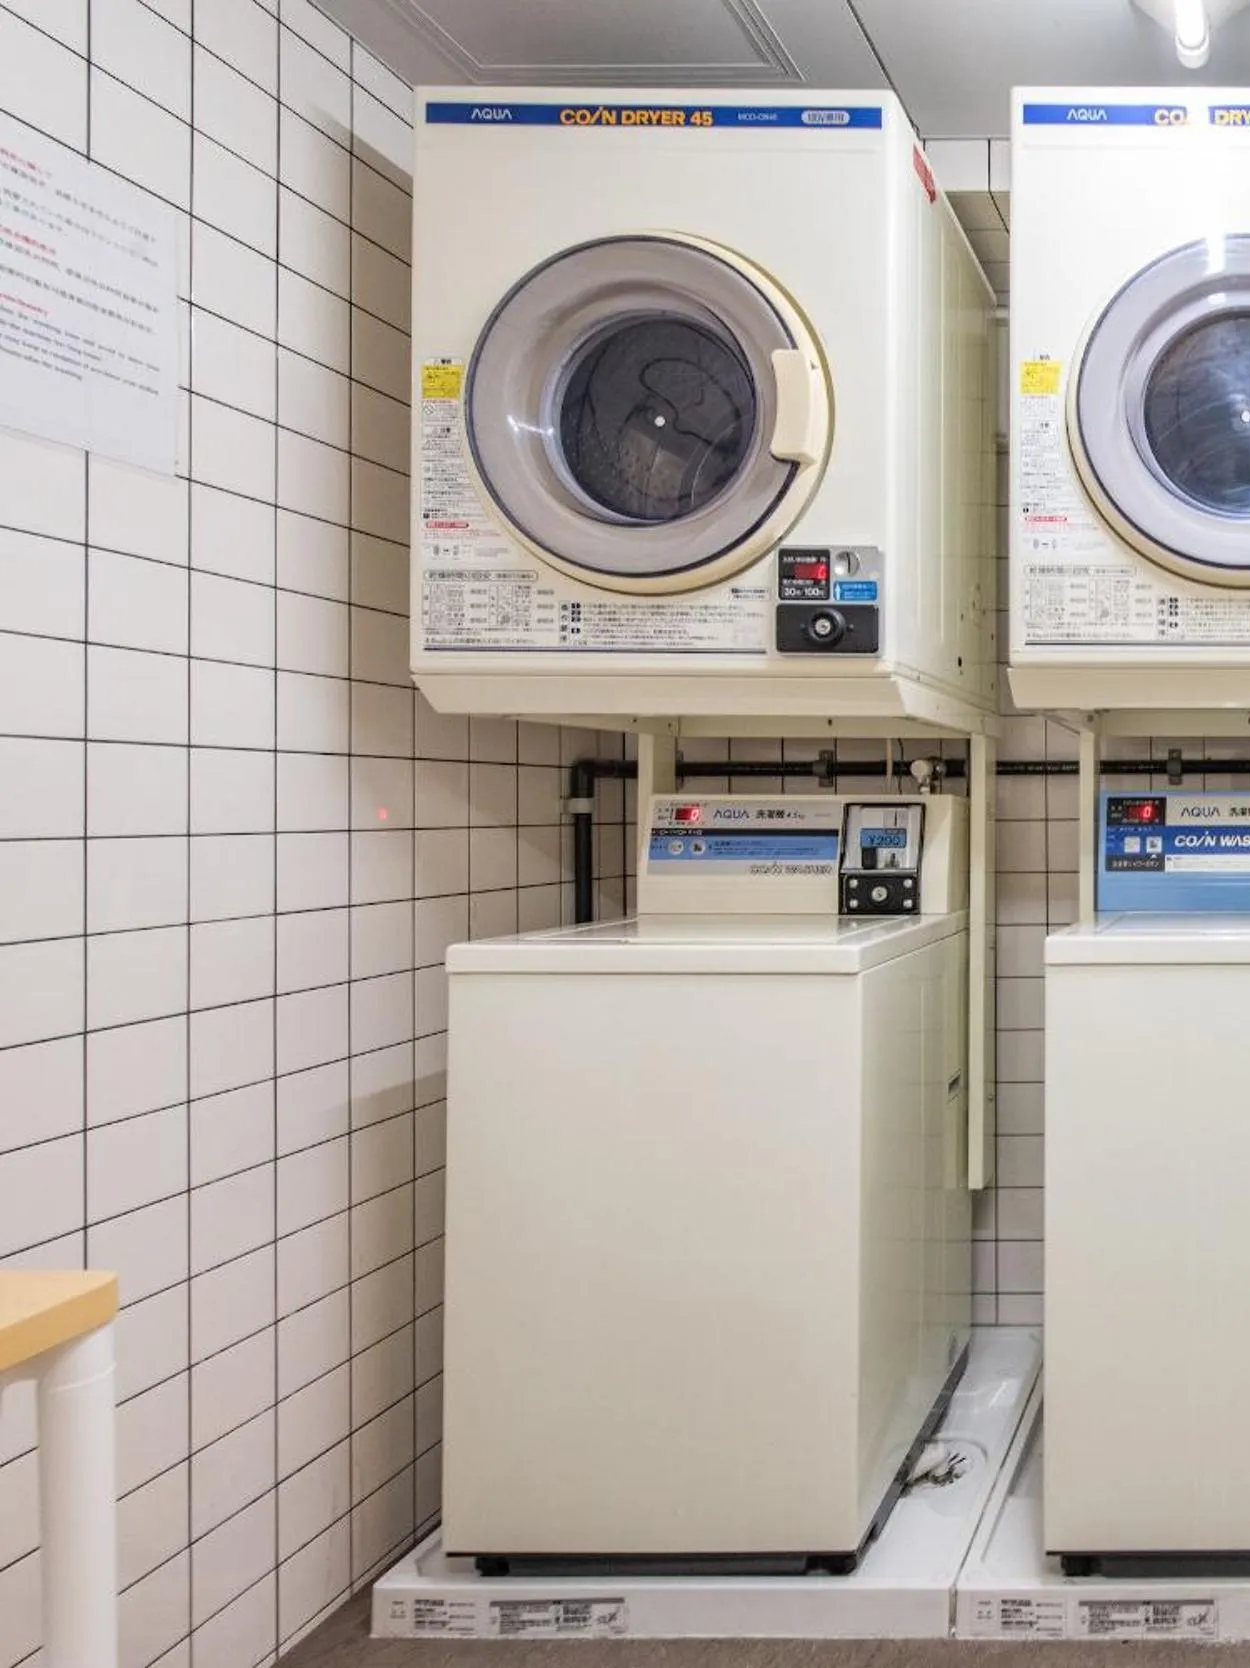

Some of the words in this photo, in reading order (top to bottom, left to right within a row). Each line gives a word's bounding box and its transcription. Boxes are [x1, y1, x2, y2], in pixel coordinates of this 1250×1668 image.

[471, 108, 513, 120] AQUA
[621, 110, 686, 125] DRYER
[690, 111, 713, 125] 45
[1067, 108, 1107, 120] AQUA
[713, 810, 750, 819] AQUA
[1181, 807, 1220, 817] AQUA
